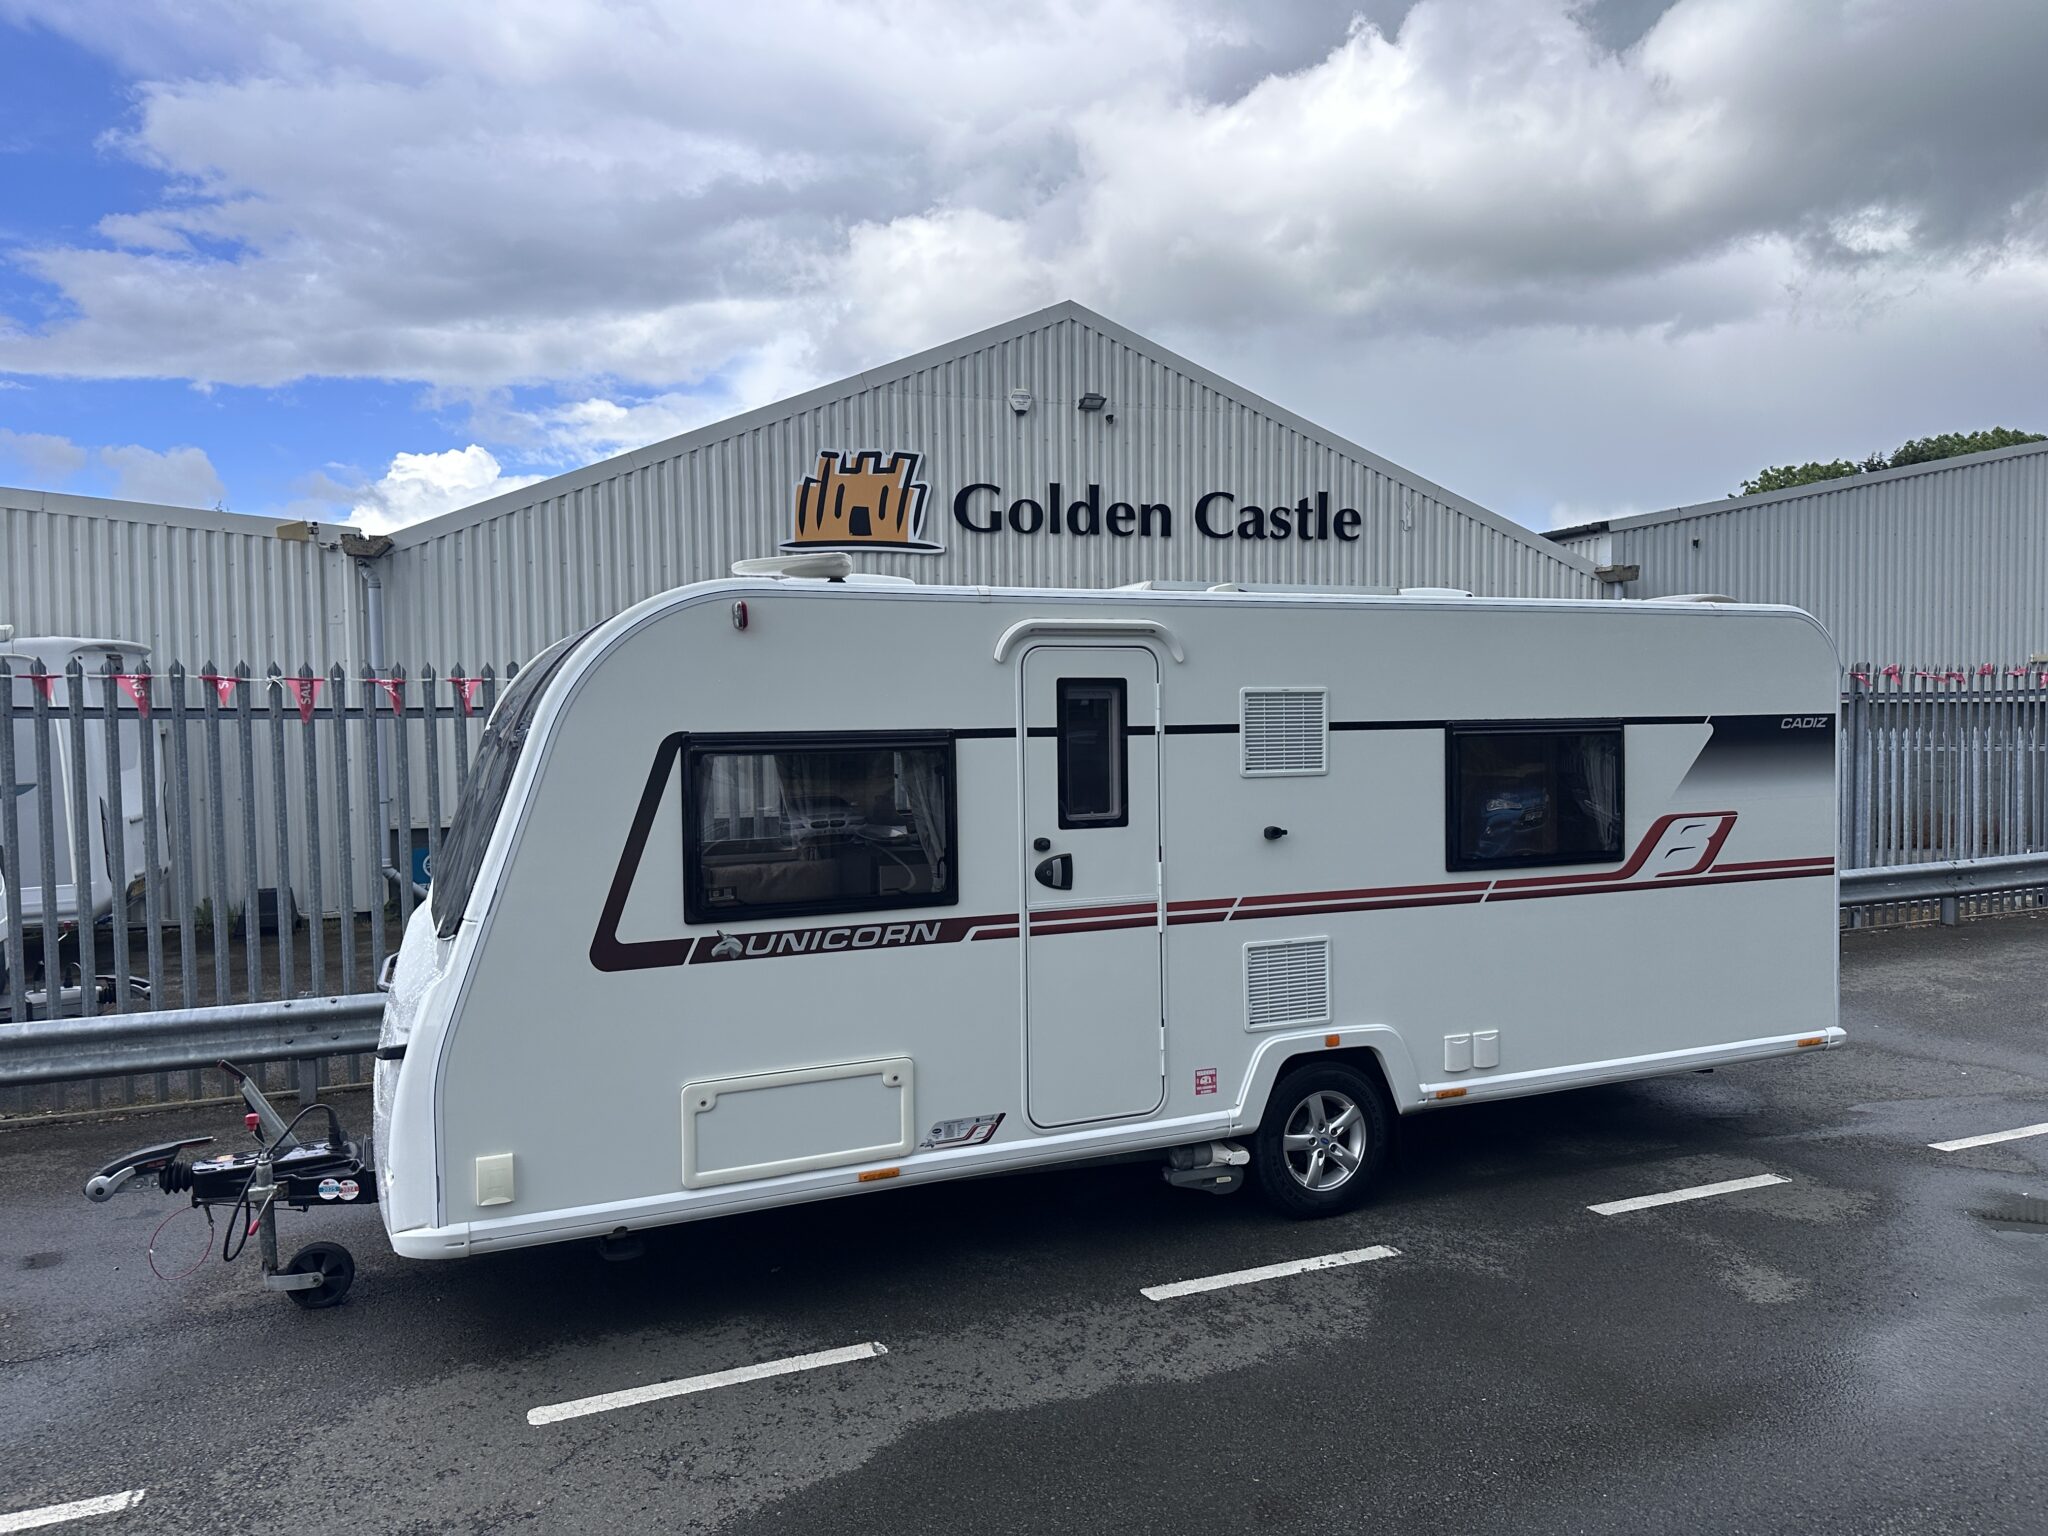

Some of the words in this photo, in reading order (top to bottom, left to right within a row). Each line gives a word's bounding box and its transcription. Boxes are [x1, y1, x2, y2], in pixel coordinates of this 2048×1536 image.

[953, 482, 1172, 537] Golden
[1195, 491, 1362, 541] Castle
[1780, 717, 1828, 729] CADIZ
[745, 921, 942, 956] UNICORN
